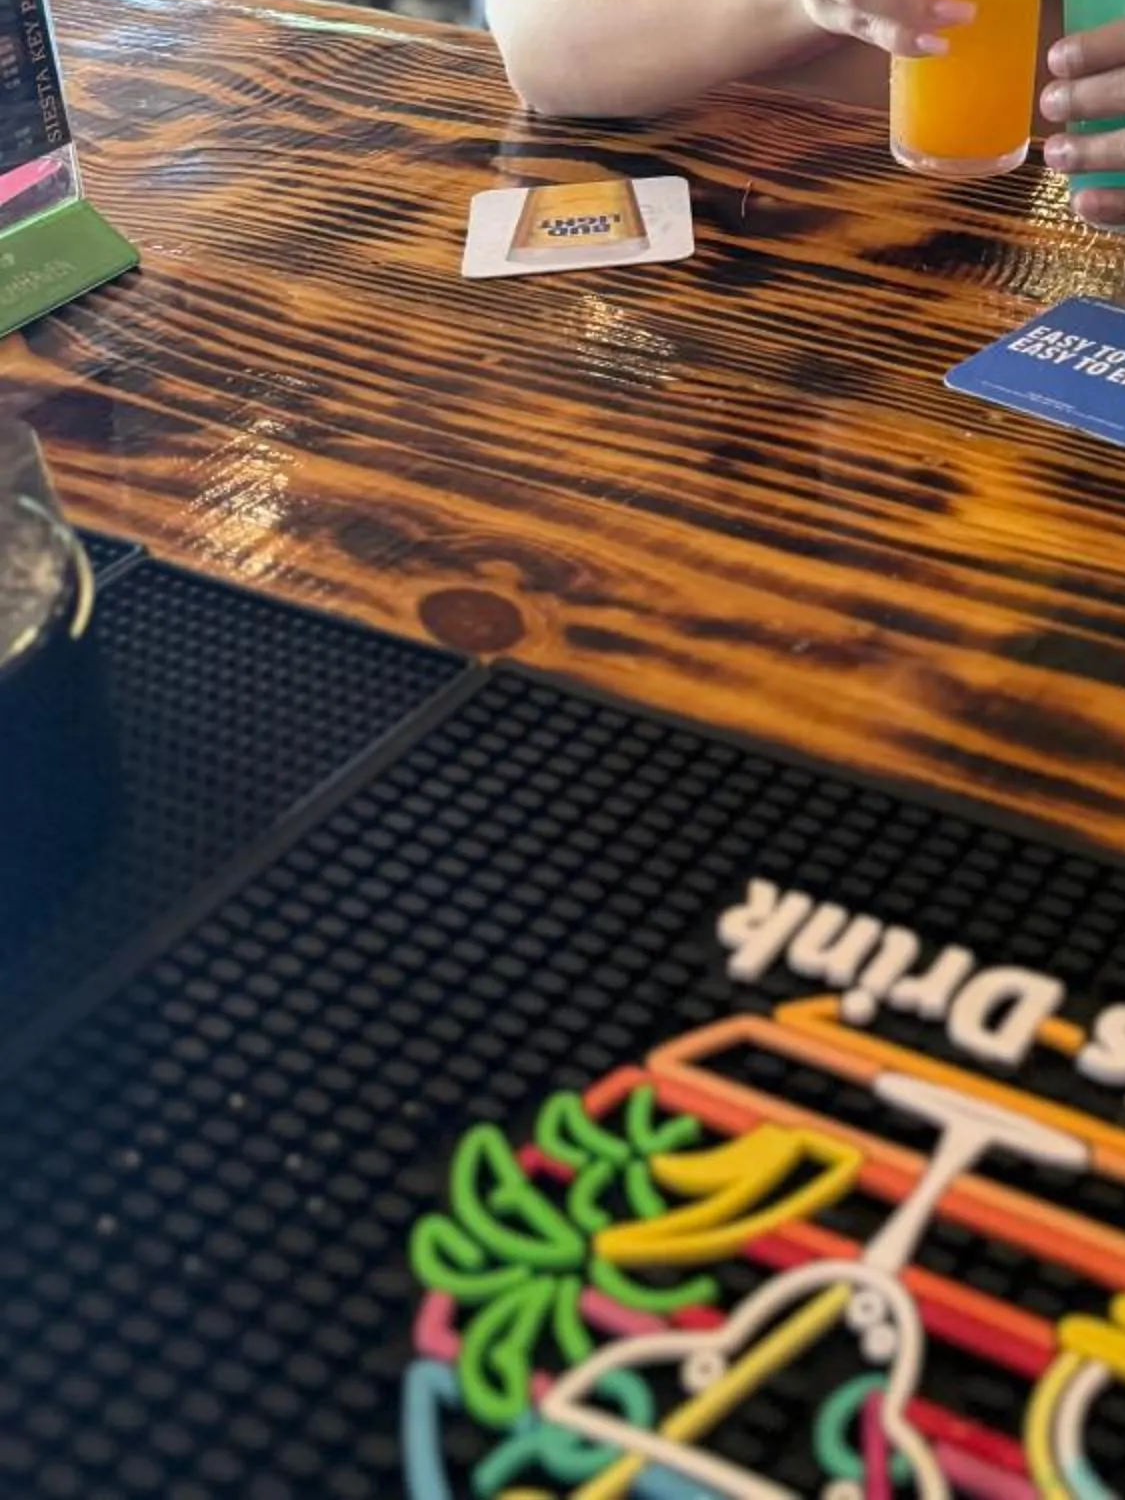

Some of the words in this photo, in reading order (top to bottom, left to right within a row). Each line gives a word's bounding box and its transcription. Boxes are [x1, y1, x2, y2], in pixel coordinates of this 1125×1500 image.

[25, 20, 47, 64] KEY
[35, 66, 63, 144] SIESTA
[1007, 337, 1077, 365] EASY
[1072, 356, 1111, 377] TO
[1026, 325, 1097, 351] EASY
[716, 876, 1066, 1066] Drink
